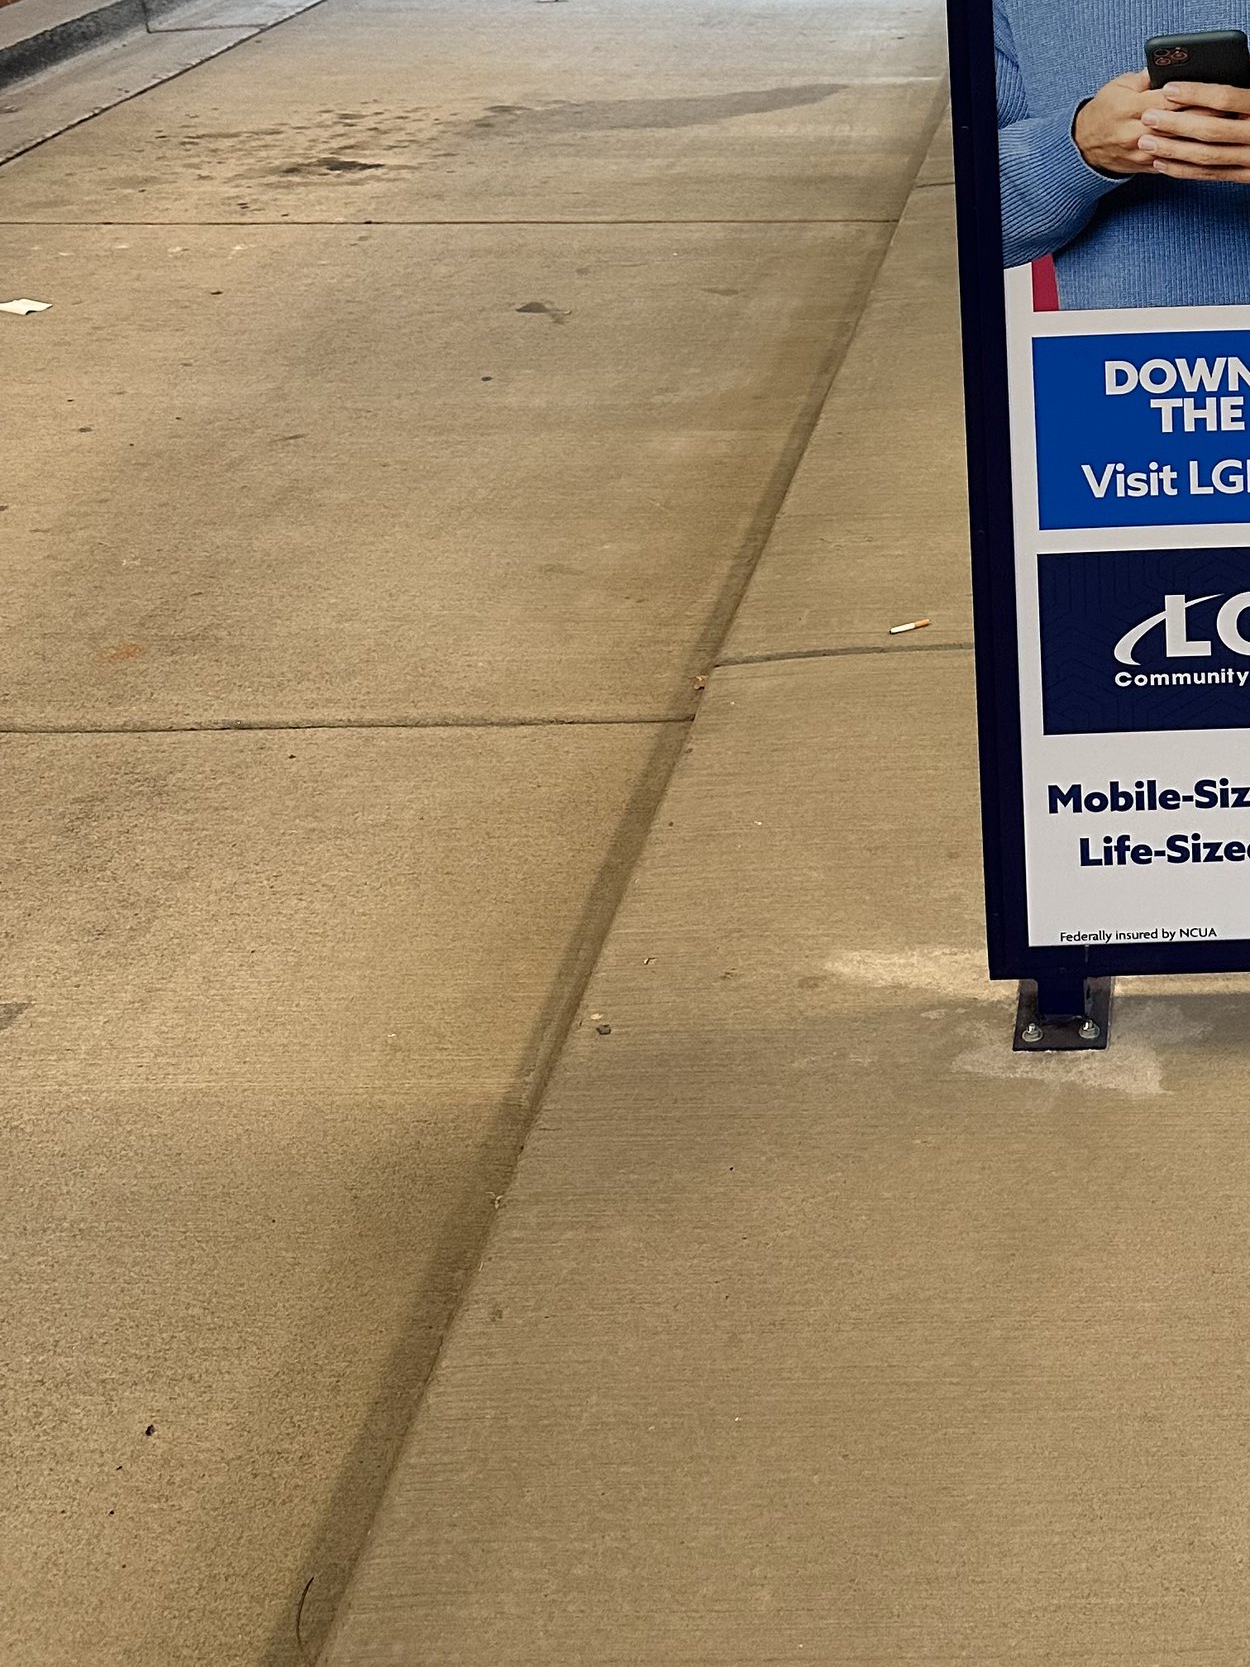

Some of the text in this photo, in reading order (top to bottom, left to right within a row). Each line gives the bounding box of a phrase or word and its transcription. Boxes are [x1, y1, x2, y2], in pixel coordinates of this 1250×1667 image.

[1150, 397, 1246, 433] THE
[1081, 461, 1178, 498] Visit
[1114, 668, 1250, 687] Community
[1060, 927, 1218, 944] Federally insured by NCUA
